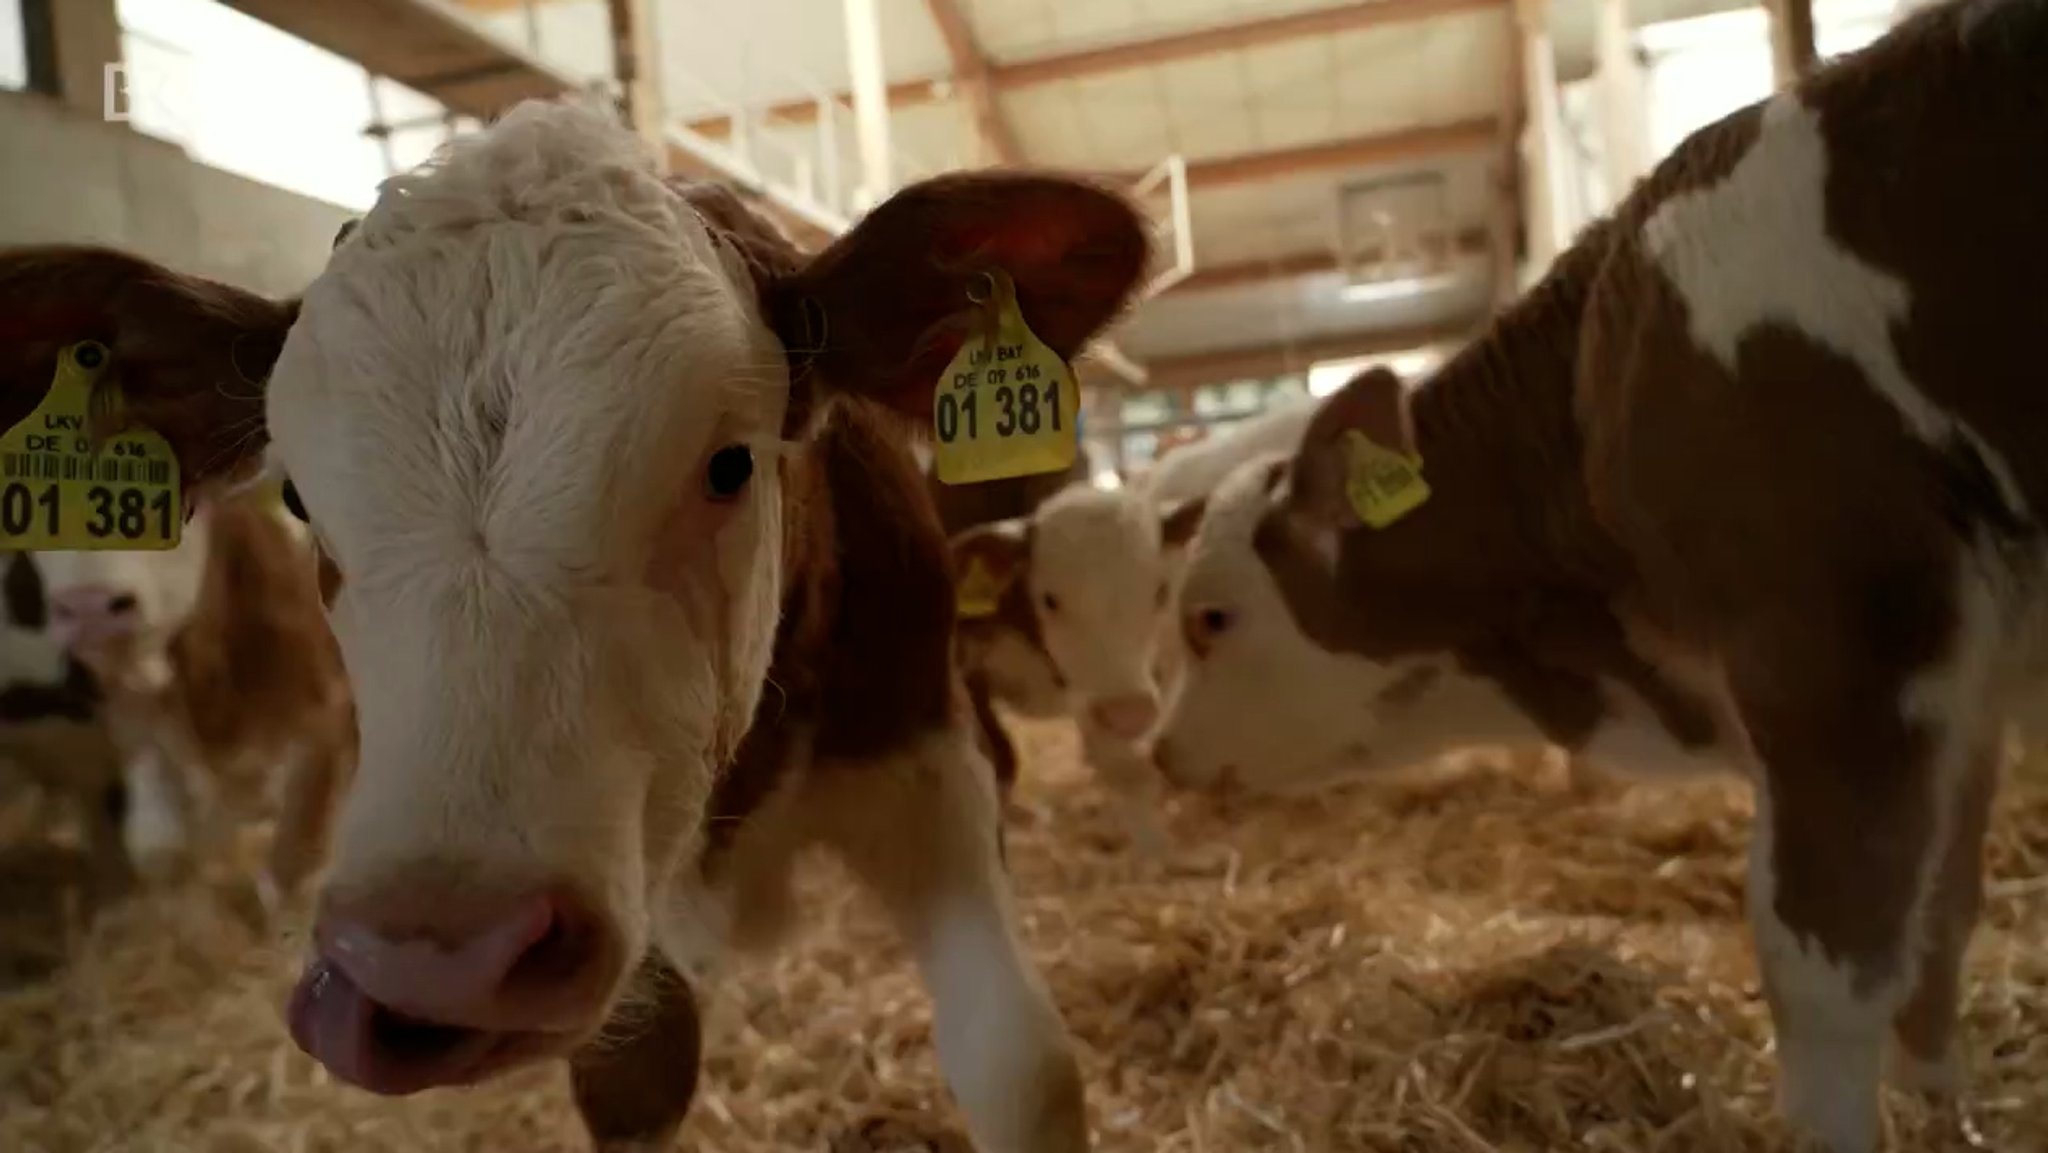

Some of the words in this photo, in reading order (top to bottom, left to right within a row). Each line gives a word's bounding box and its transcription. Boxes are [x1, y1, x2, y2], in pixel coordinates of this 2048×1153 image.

[954, 373, 978, 389] DE
[987, 369, 1007, 385] 09
[1015, 364, 1041, 381] 616
[45, 415, 83, 430] LKV
[937, 389, 977, 443] 01
[995, 380, 1061, 437] 381
[26, 434, 62, 452] DE
[113, 441, 146, 457] 616
[2, 483, 60, 536] 01
[86, 486, 172, 540] 381
